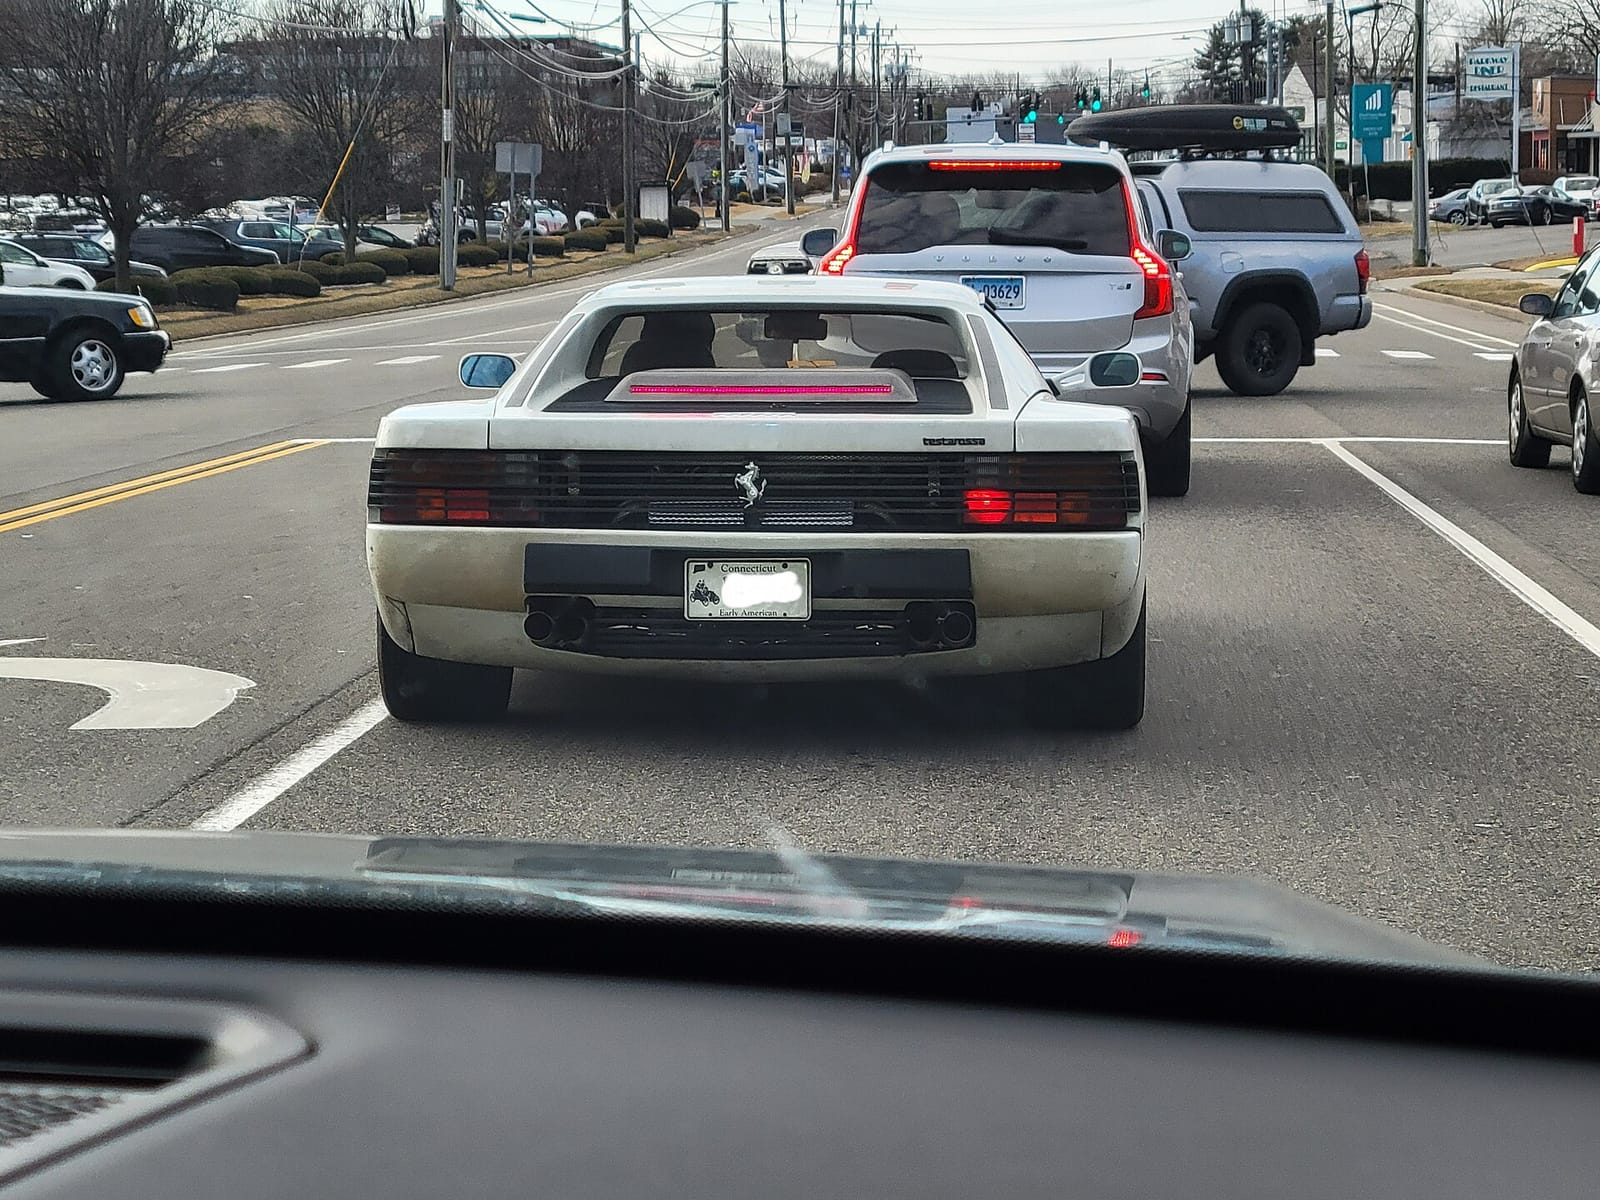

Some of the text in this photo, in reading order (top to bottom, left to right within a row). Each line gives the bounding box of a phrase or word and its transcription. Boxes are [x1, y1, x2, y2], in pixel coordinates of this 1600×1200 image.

[933, 255, 1052, 263] VOLVO
[721, 564, 776, 573] Connecticut
[719, 609, 778, 617] Early American
